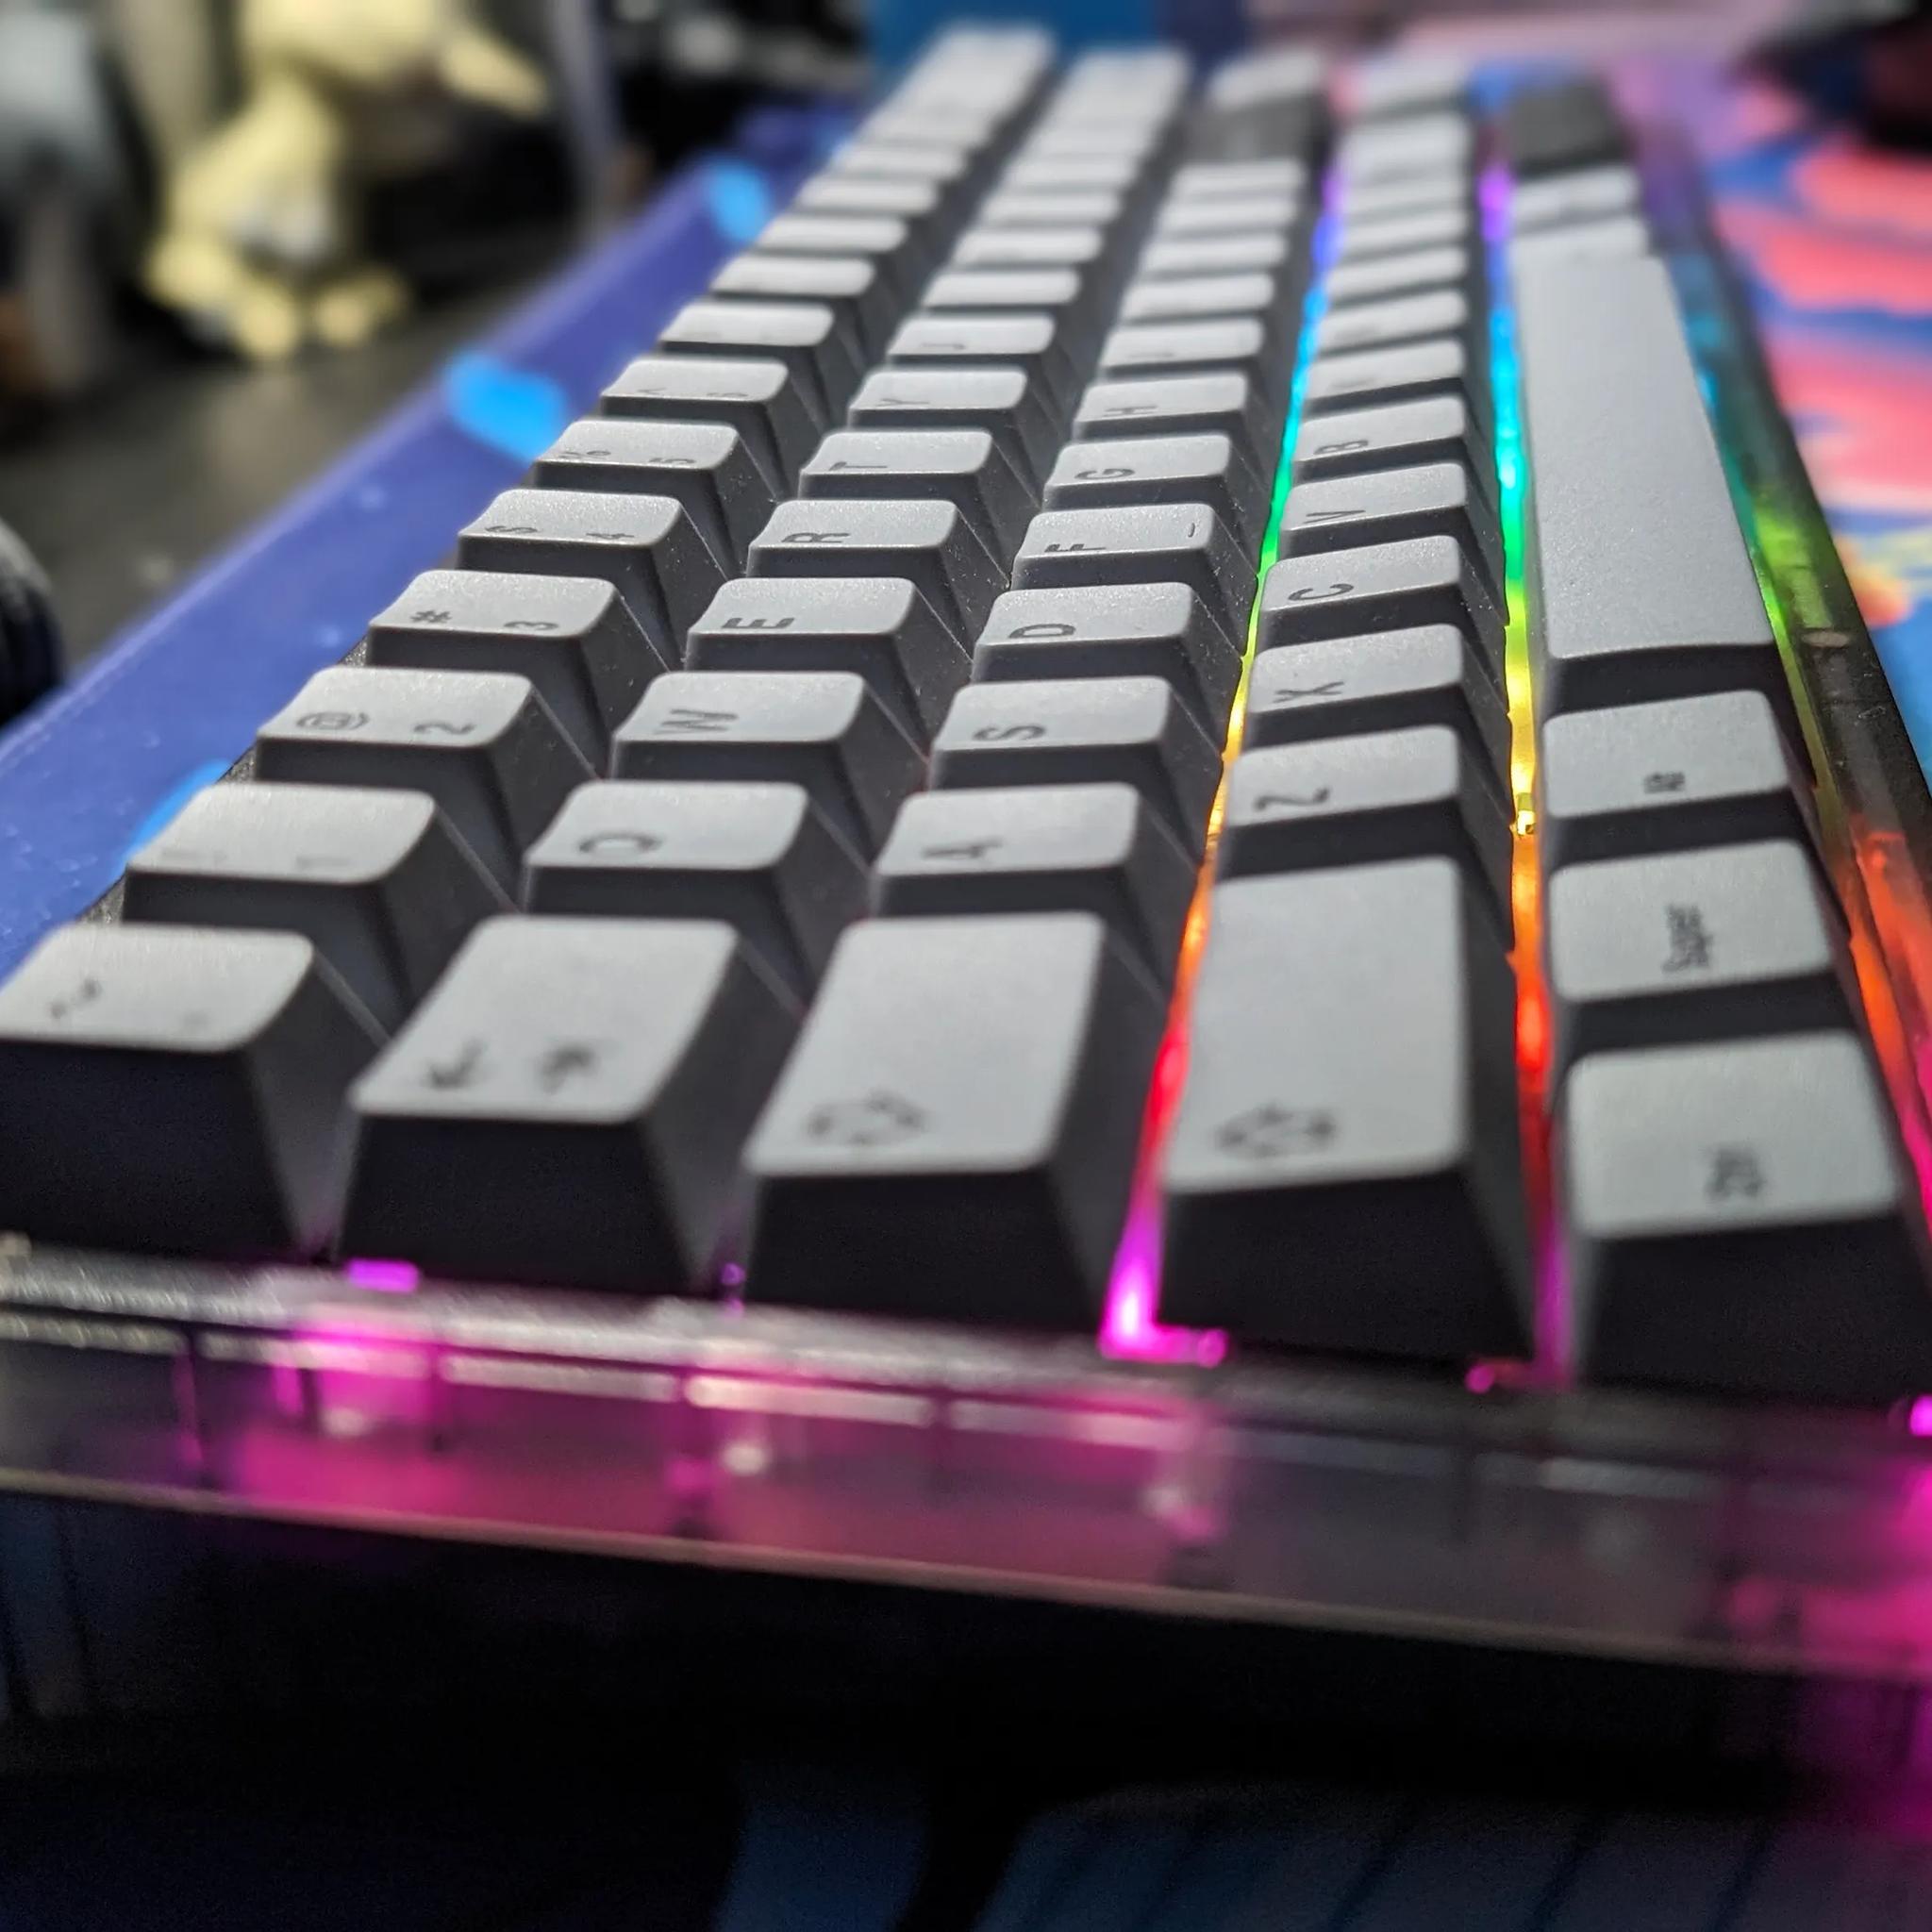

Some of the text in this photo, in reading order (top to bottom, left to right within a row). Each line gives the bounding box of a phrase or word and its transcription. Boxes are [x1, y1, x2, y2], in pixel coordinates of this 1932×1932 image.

[1312, 440, 1369, 455] B
[828, 461, 888, 471] T
[1074, 468, 1136, 479] G
[1302, 510, 1367, 525] V
[585, 532, 636, 541] 4
[781, 532, 851, 543] R
[1043, 543, 1107, 553] F
[1288, 582, 1354, 601] C
[409, 608, 451, 624] #
[721, 617, 795, 629] E
[503, 621, 559, 631] 3
[1008, 624, 1076, 639] D
[1274, 680, 1345, 703] X
[412, 720, 476, 736] 2
[972, 724, 1046, 741] S
[1251, 785, 1331, 812] Z
